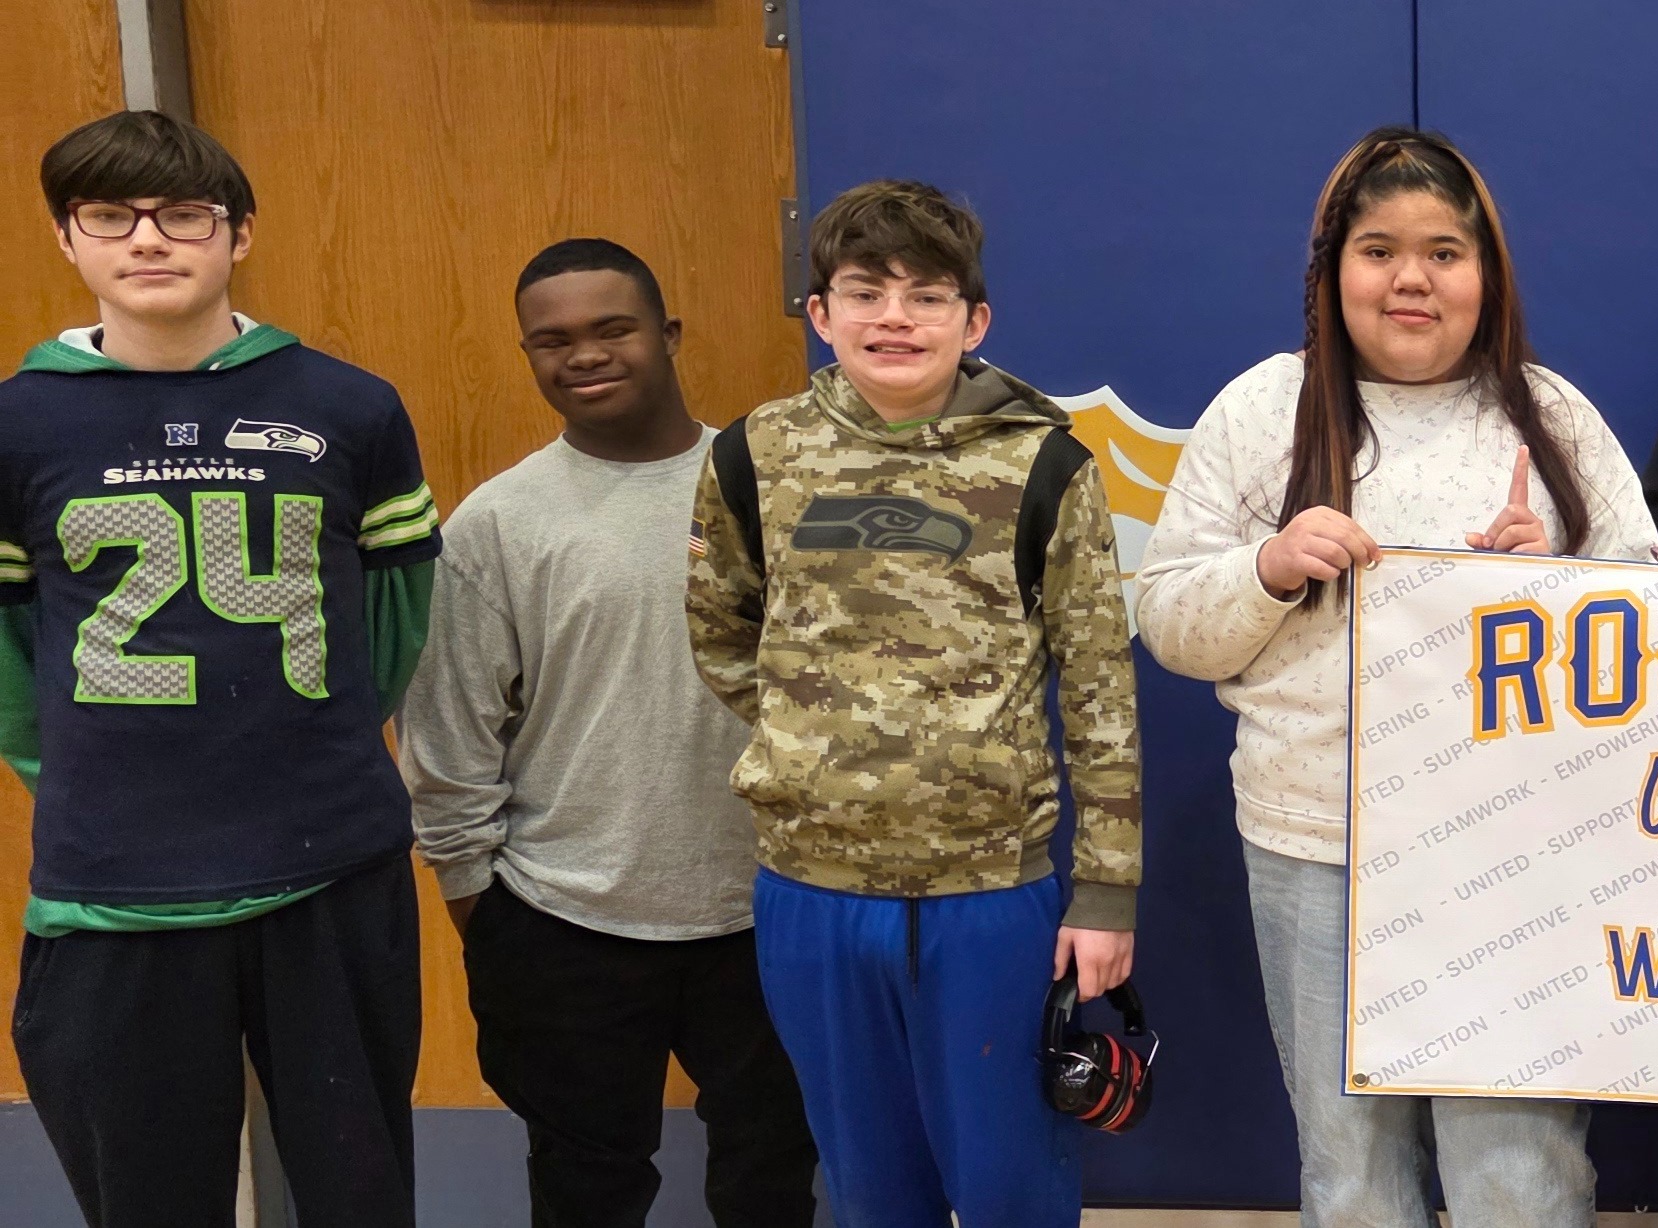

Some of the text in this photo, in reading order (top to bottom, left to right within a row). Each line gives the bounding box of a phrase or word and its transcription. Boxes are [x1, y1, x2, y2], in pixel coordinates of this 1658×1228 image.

[103, 467, 266, 484] SEAHAWKS
[132, 457, 235, 468] SEATTLE
[56, 492, 329, 705] 24
[1358, 552, 1457, 615] FEARLESS
[1416, 778, 1535, 851] TEAMWORK
[1453, 851, 1532, 903] UNITED
[1350, 976, 1429, 1028] UNITED
[1444, 903, 1571, 980] SUPPORTIVE
[1513, 963, 1590, 1013] UNITED
